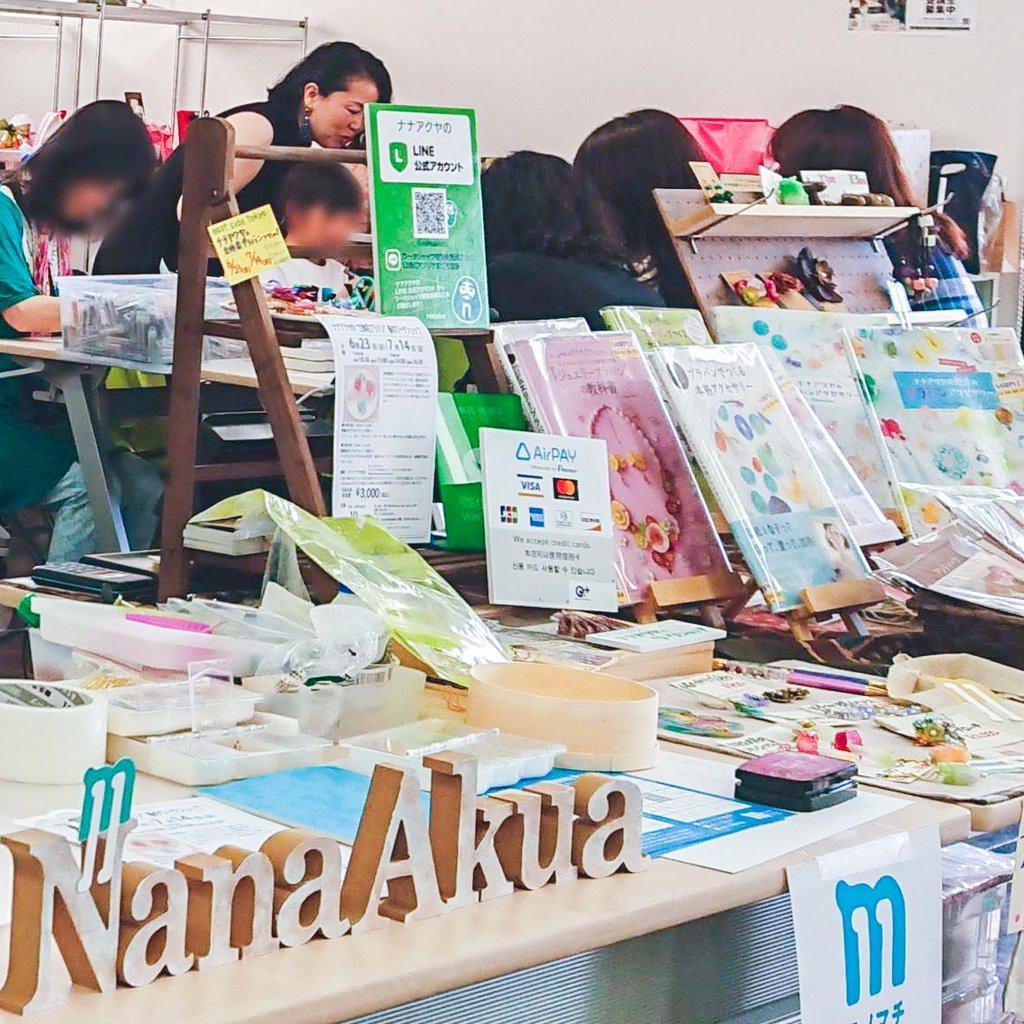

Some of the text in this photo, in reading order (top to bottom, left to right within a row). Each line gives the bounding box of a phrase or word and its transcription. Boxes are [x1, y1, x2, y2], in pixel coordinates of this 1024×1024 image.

[397, 119, 452, 134] ナナアクヤの
[413, 145, 435, 157] LINE
[414, 160, 464, 173] 公式アカウント
[533, 446, 577, 463] AirPAY
[521, 481, 541, 491] VISA
